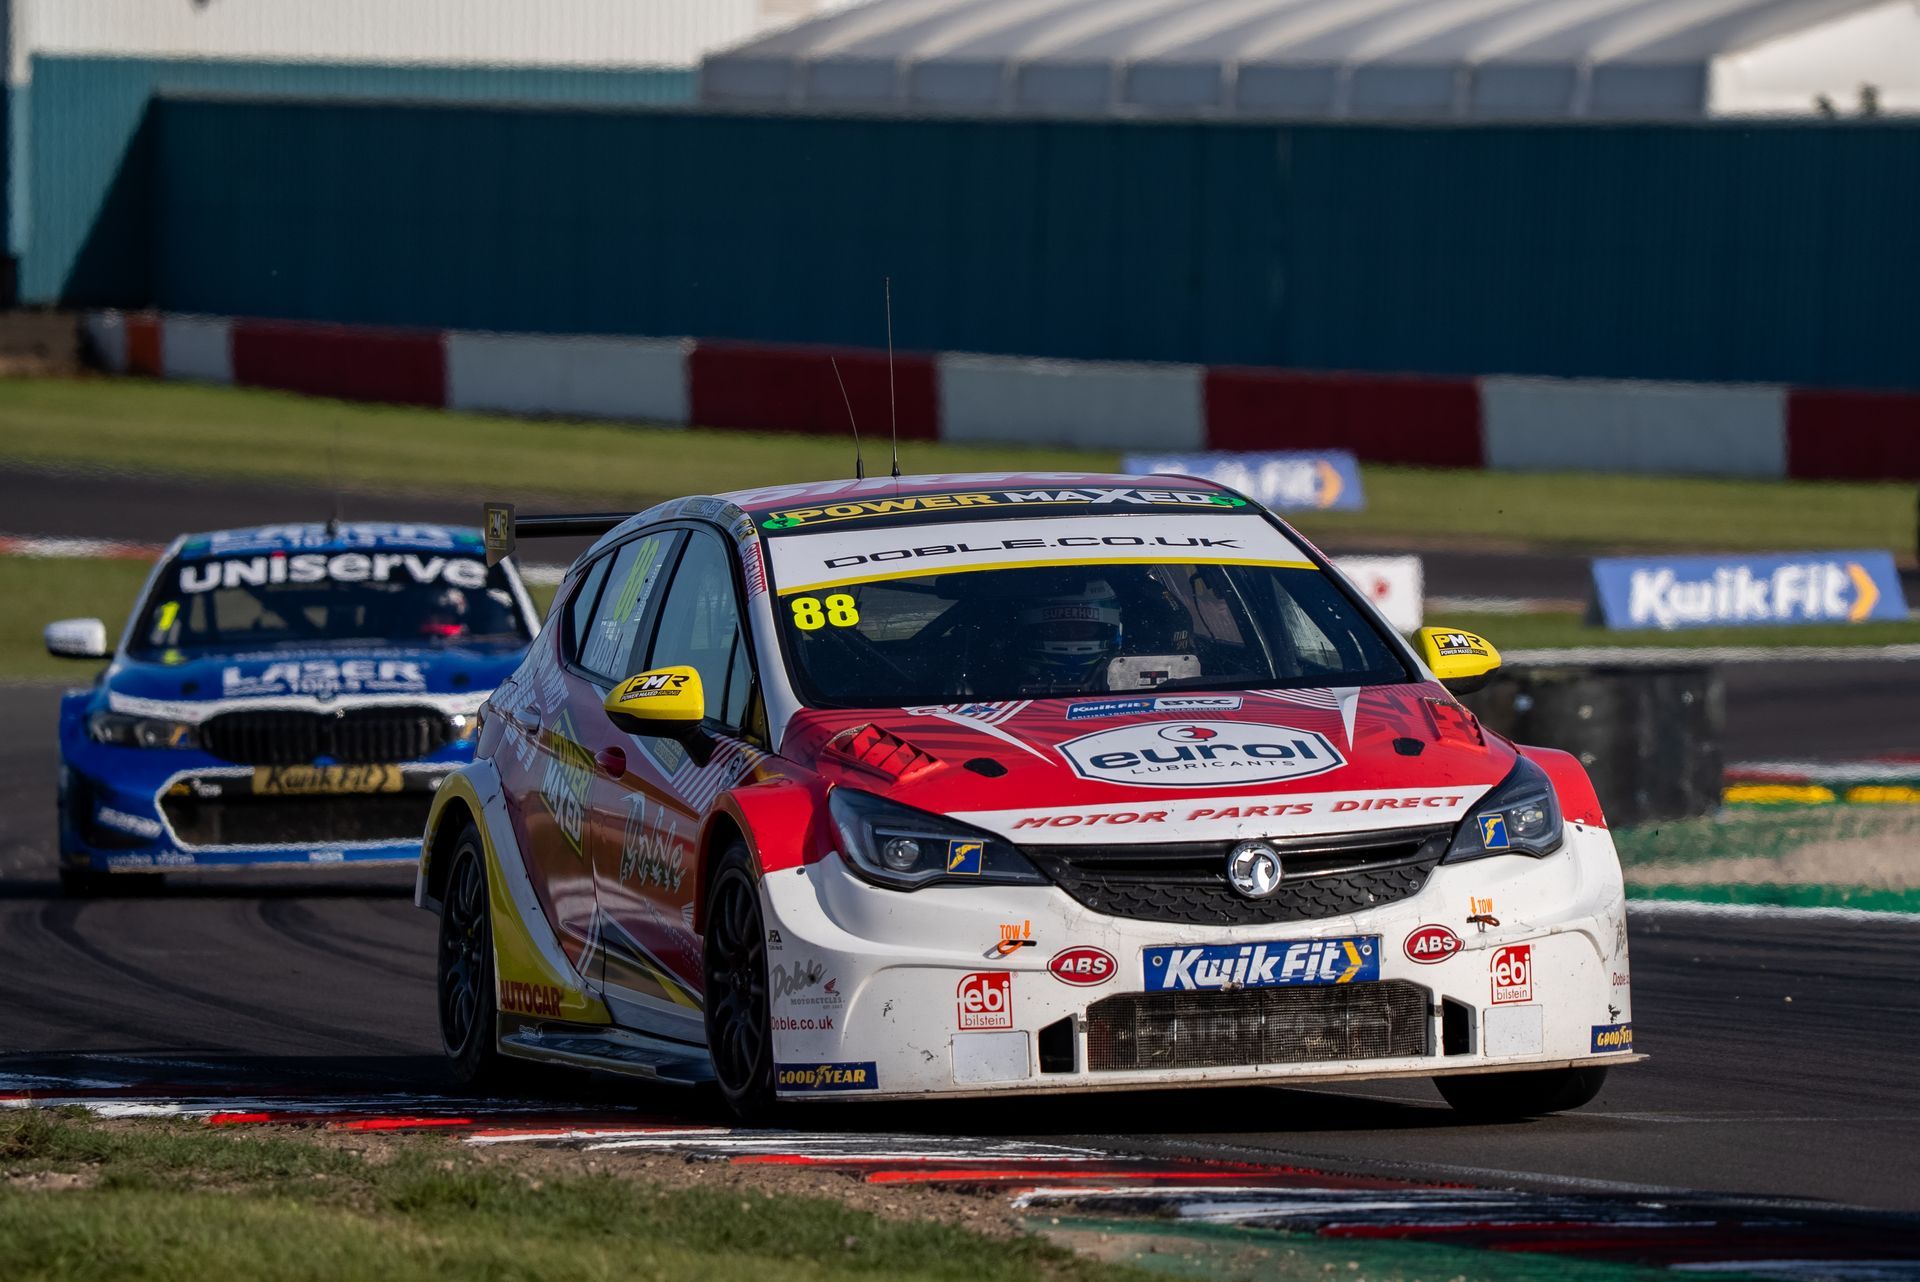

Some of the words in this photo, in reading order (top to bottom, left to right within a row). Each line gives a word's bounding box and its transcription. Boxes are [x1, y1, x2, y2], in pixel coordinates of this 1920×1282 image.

[784, 493, 998, 522] POWER
[1003, 488, 1212, 504] MAXED
[824, 536, 1245, 569] DOBLE.CO.UK
[613, 537, 660, 624] 88
[160, 602, 180, 631] 1
[792, 594, 860, 631] 88
[1434, 633, 1483, 648] PMR
[620, 692, 640, 701] POWER
[640, 690, 658, 698] MAXED
[626, 674, 690, 692] PMR
[551, 719, 594, 798] POWER
[1089, 738, 1316, 769] eurol
[1131, 759, 1295, 775] LUBRICANTS
[542, 756, 584, 842] MAXED
[1012, 810, 1168, 830] MOTOR
[1187, 803, 1314, 822] PARTS
[1330, 796, 1464, 813] DIRECT
[1478, 898, 1493, 914] TOW
[1000, 924, 1020, 939] TOW
[1413, 935, 1457, 955] ABS
[1060, 956, 1108, 974] ABS
[1491, 953, 1530, 987] febi
[500, 980, 563, 1016] AUTOCAR
[770, 959, 828, 1007] Doble
[957, 974, 1011, 1012] febi
[1496, 988, 1528, 1000] bilstein
[771, 1015, 834, 1031] Doble.co.uk
[965, 1014, 1006, 1027] bilstein
